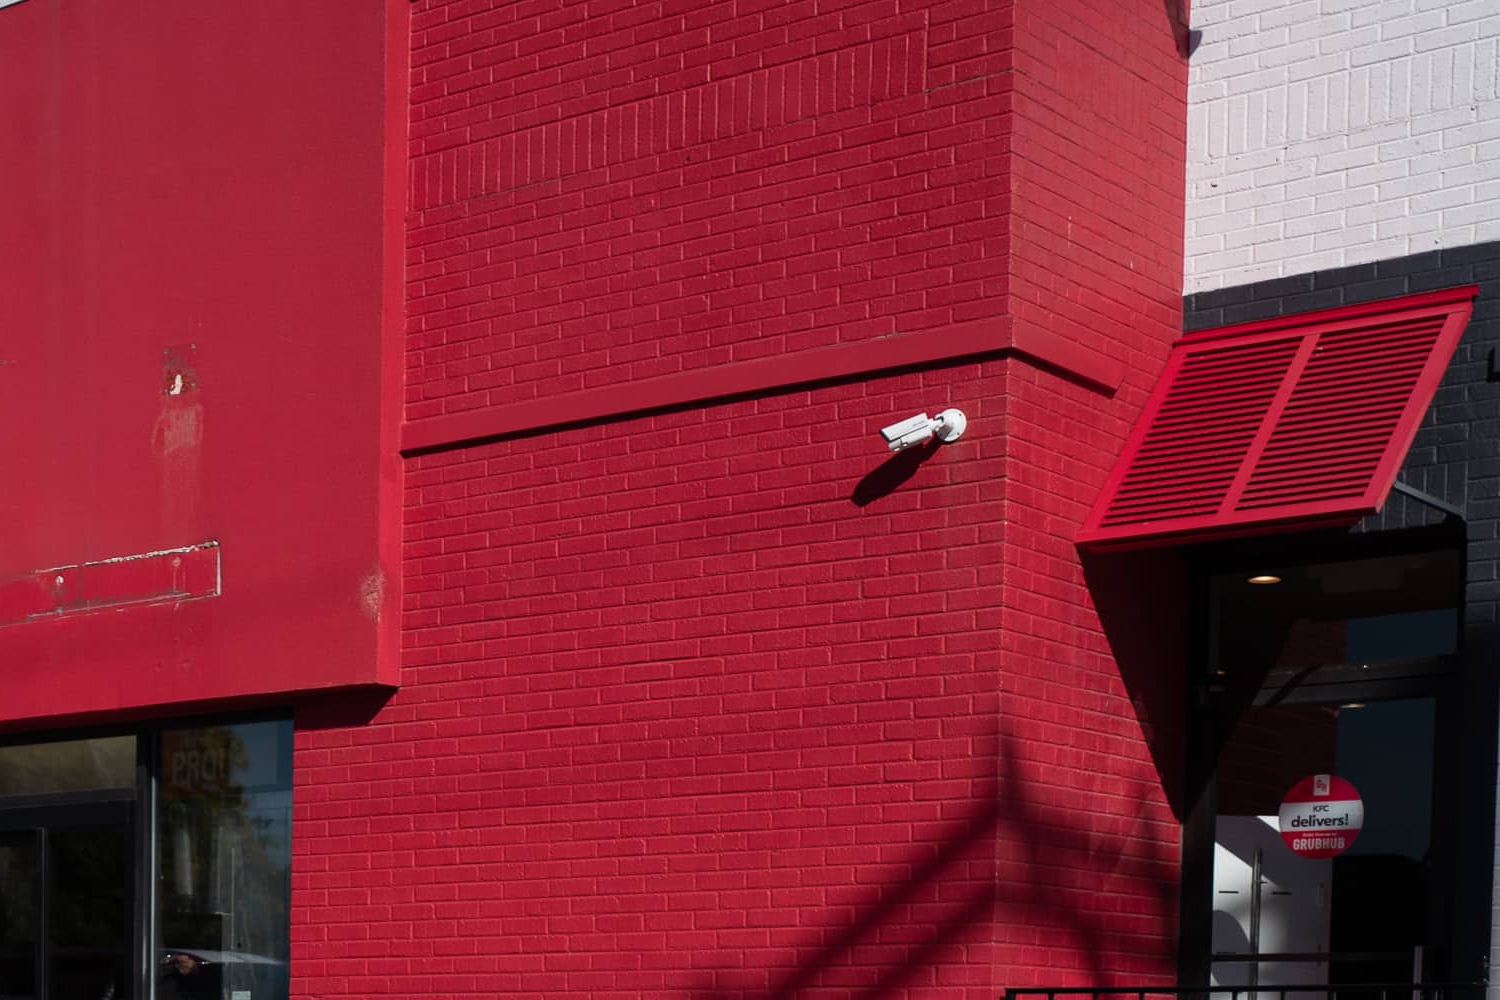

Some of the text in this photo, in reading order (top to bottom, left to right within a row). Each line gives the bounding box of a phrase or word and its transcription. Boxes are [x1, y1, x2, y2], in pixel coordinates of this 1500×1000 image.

[1313, 804, 1329, 812] KFC
[1291, 813, 1349, 828] delivers!
[1293, 837, 1345, 850] GRUBHUB
